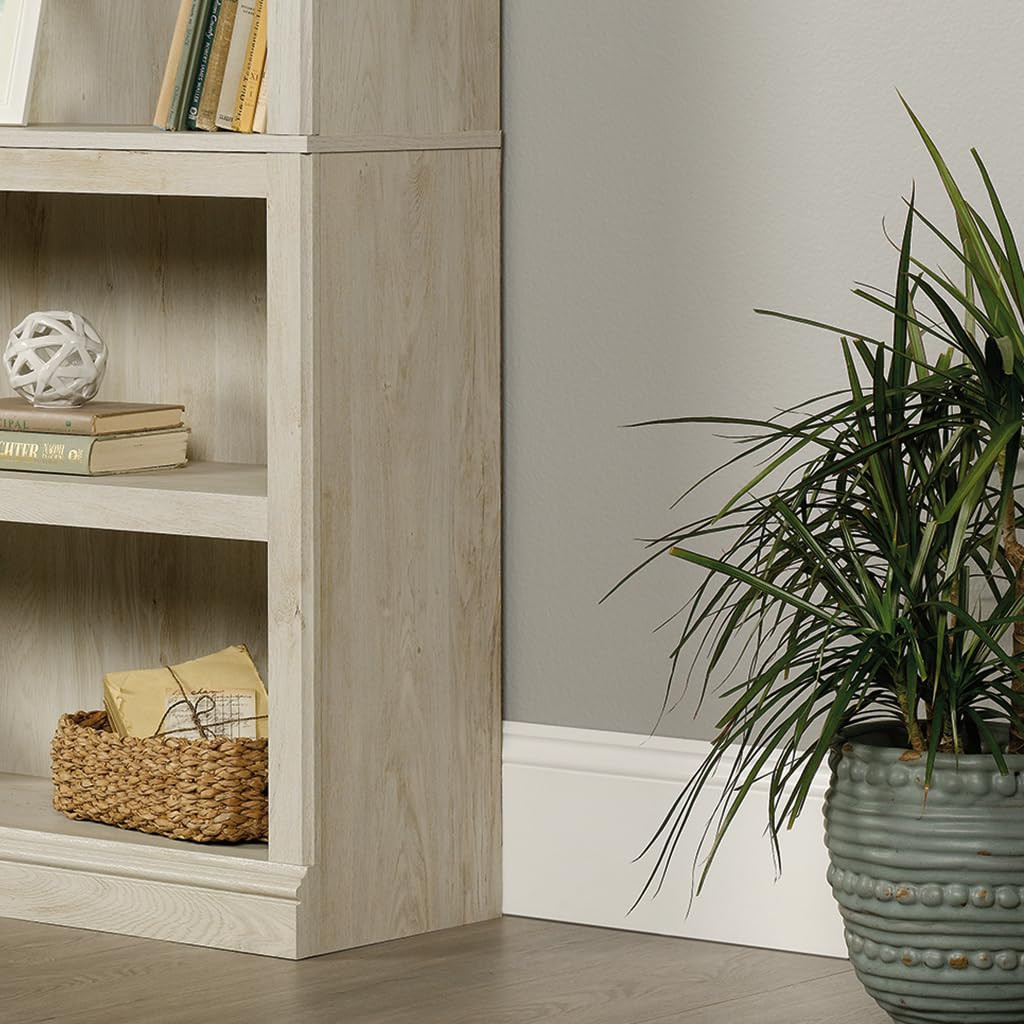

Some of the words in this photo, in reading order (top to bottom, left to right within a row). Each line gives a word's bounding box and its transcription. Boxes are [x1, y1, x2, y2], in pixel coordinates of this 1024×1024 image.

[206, 14, 217, 39] County
[202, 41, 210, 62] ROBERT
[198, 63, 206, 81] JAMES
[193, 81, 202, 103] WALLER
